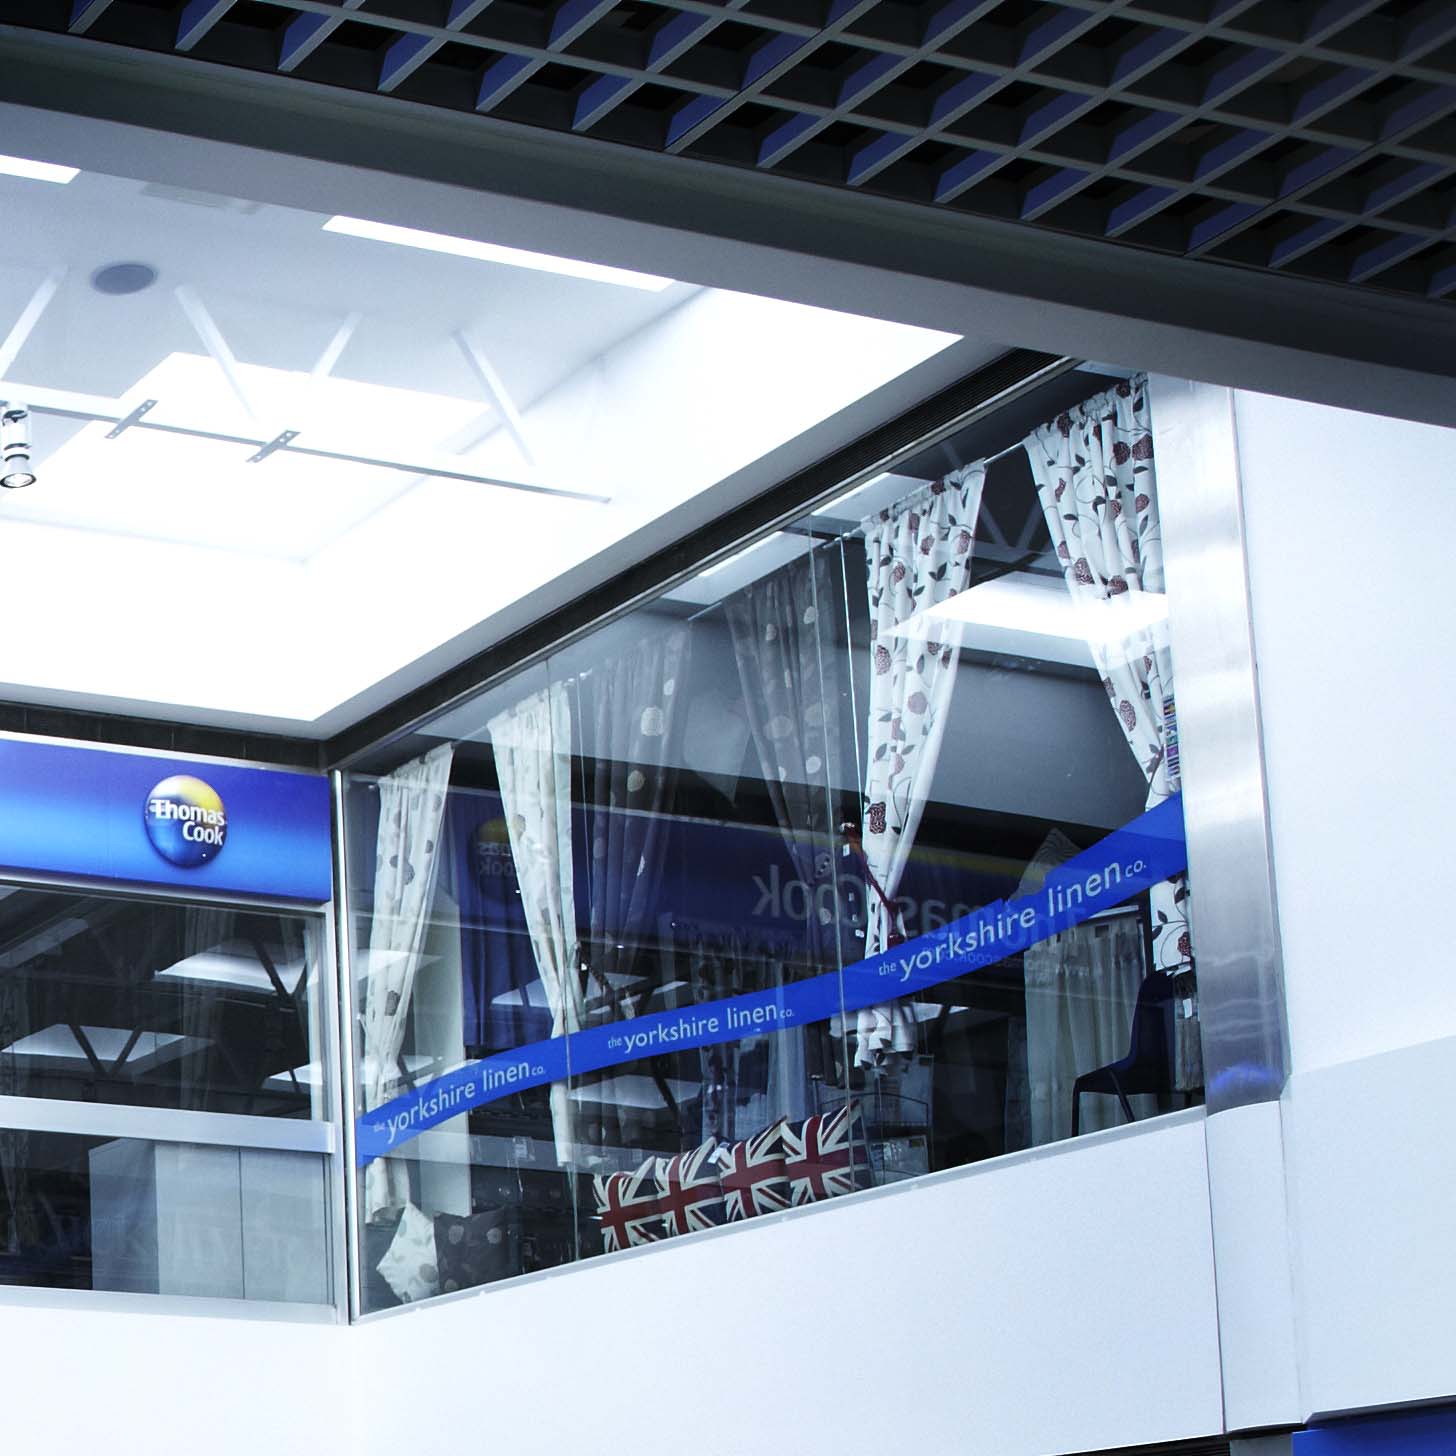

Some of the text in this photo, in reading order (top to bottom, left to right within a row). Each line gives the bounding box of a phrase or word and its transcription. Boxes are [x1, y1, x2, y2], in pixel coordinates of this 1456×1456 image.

[150, 799, 225, 826] Thomas
[182, 820, 224, 846] Cook
[878, 961, 897, 977] the
[899, 903, 1037, 983] yorkshire
[1047, 861, 1122, 917] linen
[1124, 858, 1147, 878] co.
[608, 1003, 795, 1053] the yorkshire linen co.
[387, 1081, 476, 1144] yorkshire
[483, 1061, 530, 1091] linen
[531, 1064, 546, 1076] co.
